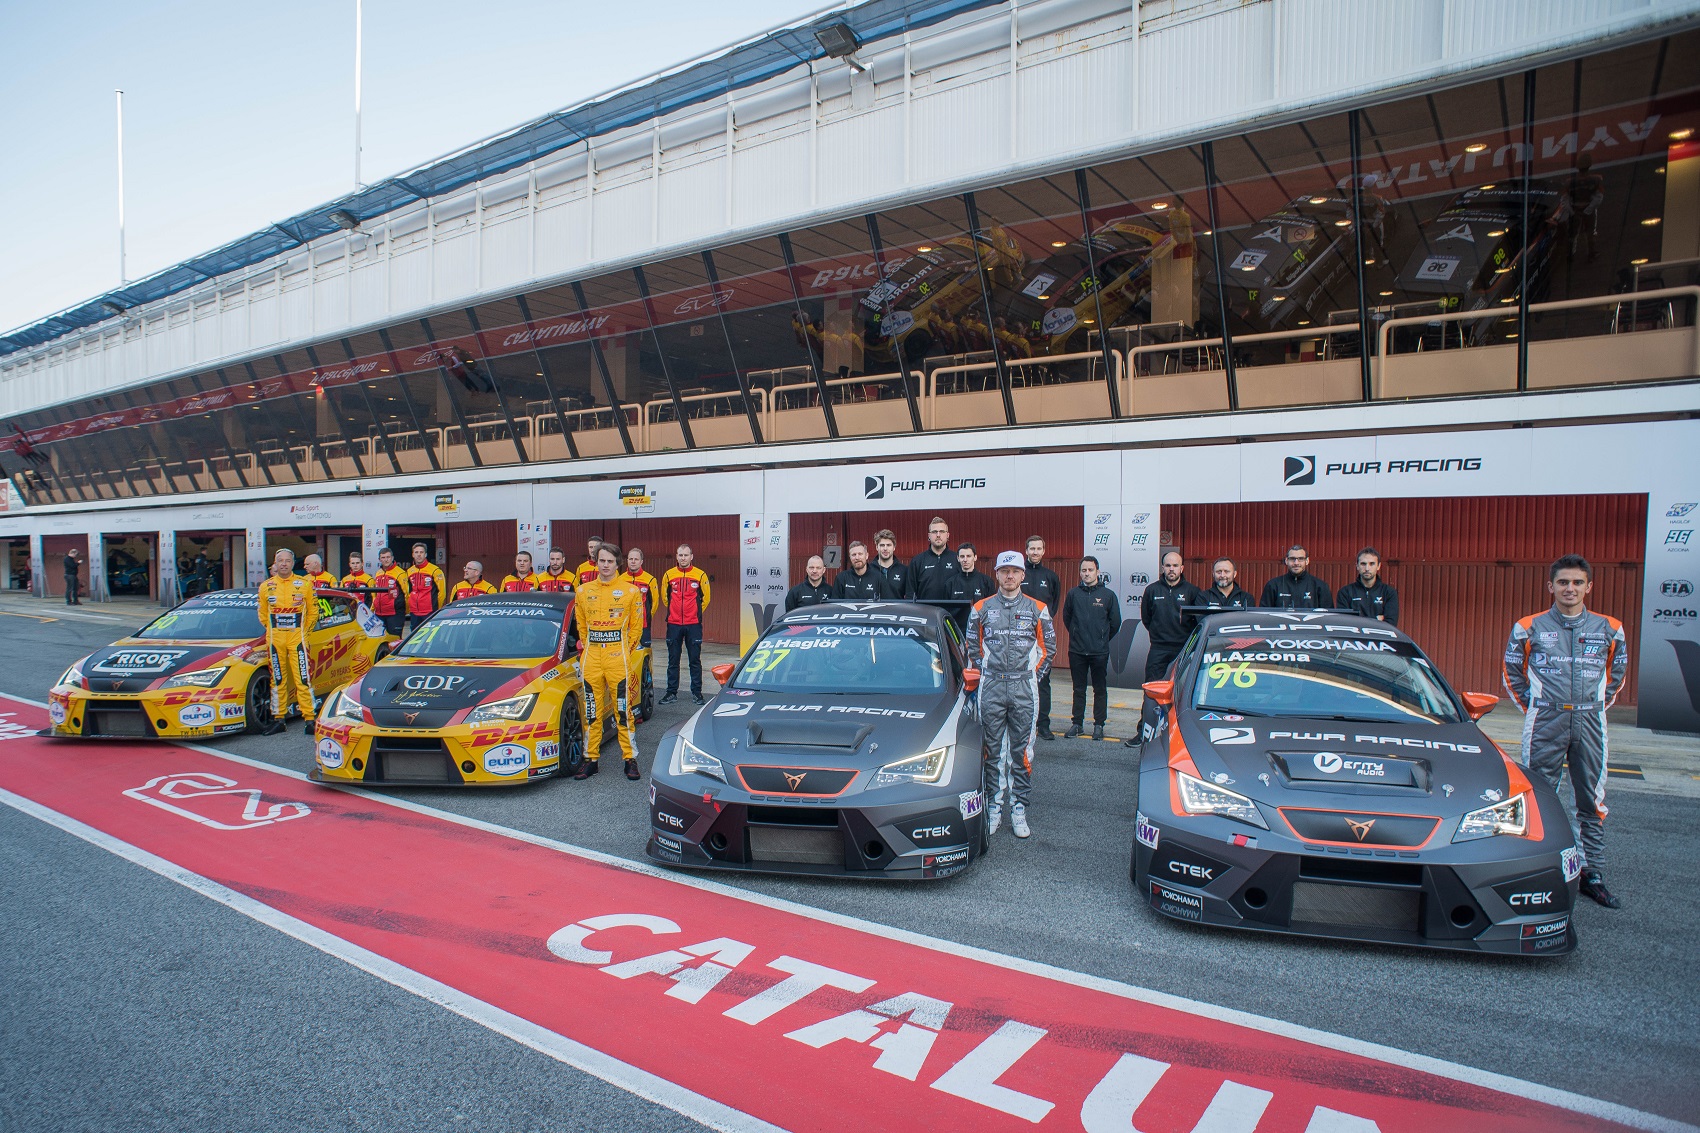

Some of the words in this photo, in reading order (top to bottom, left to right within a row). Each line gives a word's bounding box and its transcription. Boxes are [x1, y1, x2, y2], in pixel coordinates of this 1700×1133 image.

[1325, 461, 1382, 476] PWR
[1387, 457, 1482, 473] RACING
[890, 480, 925, 491] PWR
[928, 477, 986, 490] RACING
[306, 505, 320, 514] Sport
[1094, 533, 1111, 545] 96
[1131, 533, 1148, 545] 96
[1664, 530, 1694, 545] 96
[438, 551, 443, 560] 9
[829, 551, 836, 563] 7
[319, 598, 333, 617] 50
[491, 600, 554, 608] AUTOMOBILES
[466, 608, 546, 617] YOKOHAMA
[783, 613, 928, 624] CUPRA
[1653, 607, 1698, 619] panta
[439, 617, 483, 626] Panis
[408, 627, 441, 645] 21
[815, 626, 920, 637] YOKOHAMA
[1218, 624, 1398, 638] CUPRA
[757, 638, 841, 650] D.Haglöf
[1265, 639, 1397, 652] YOKOHAMA
[1583, 645, 1600, 654] 96
[745, 649, 791, 673] 37
[1203, 651, 1311, 663] M.Azcona
[1574, 657, 1605, 665] RACING
[272, 653, 282, 681] TRICORP
[298, 650, 308, 680] TRICORP
[338, 666, 352, 677] YEARS
[1208, 662, 1257, 688] 96
[403, 675, 465, 690] GDP
[163, 687, 240, 705] DHL
[182, 710, 212, 720] eurol
[224, 705, 244, 717] KW
[760, 704, 823, 712] PWR
[827, 705, 926, 719] RACING
[470, 721, 554, 748] DHL
[1269, 731, 1346, 741] PWR
[1354, 734, 1482, 754] RACING
[320, 749, 341, 761] eurol
[541, 744, 559, 757] KW
[488, 754, 526, 767] eurol
[1356, 769, 1385, 777] AUDIO
[658, 811, 684, 828] CTEK
[912, 825, 951, 839] CTEK
[935, 851, 967, 863] YOKOHAMA
[1168, 860, 1213, 880] CTEK
[1161, 889, 1200, 908] YOKOHAMA
[1509, 891, 1553, 906] CTEK
[546, 912, 1381, 1133] CATALU
